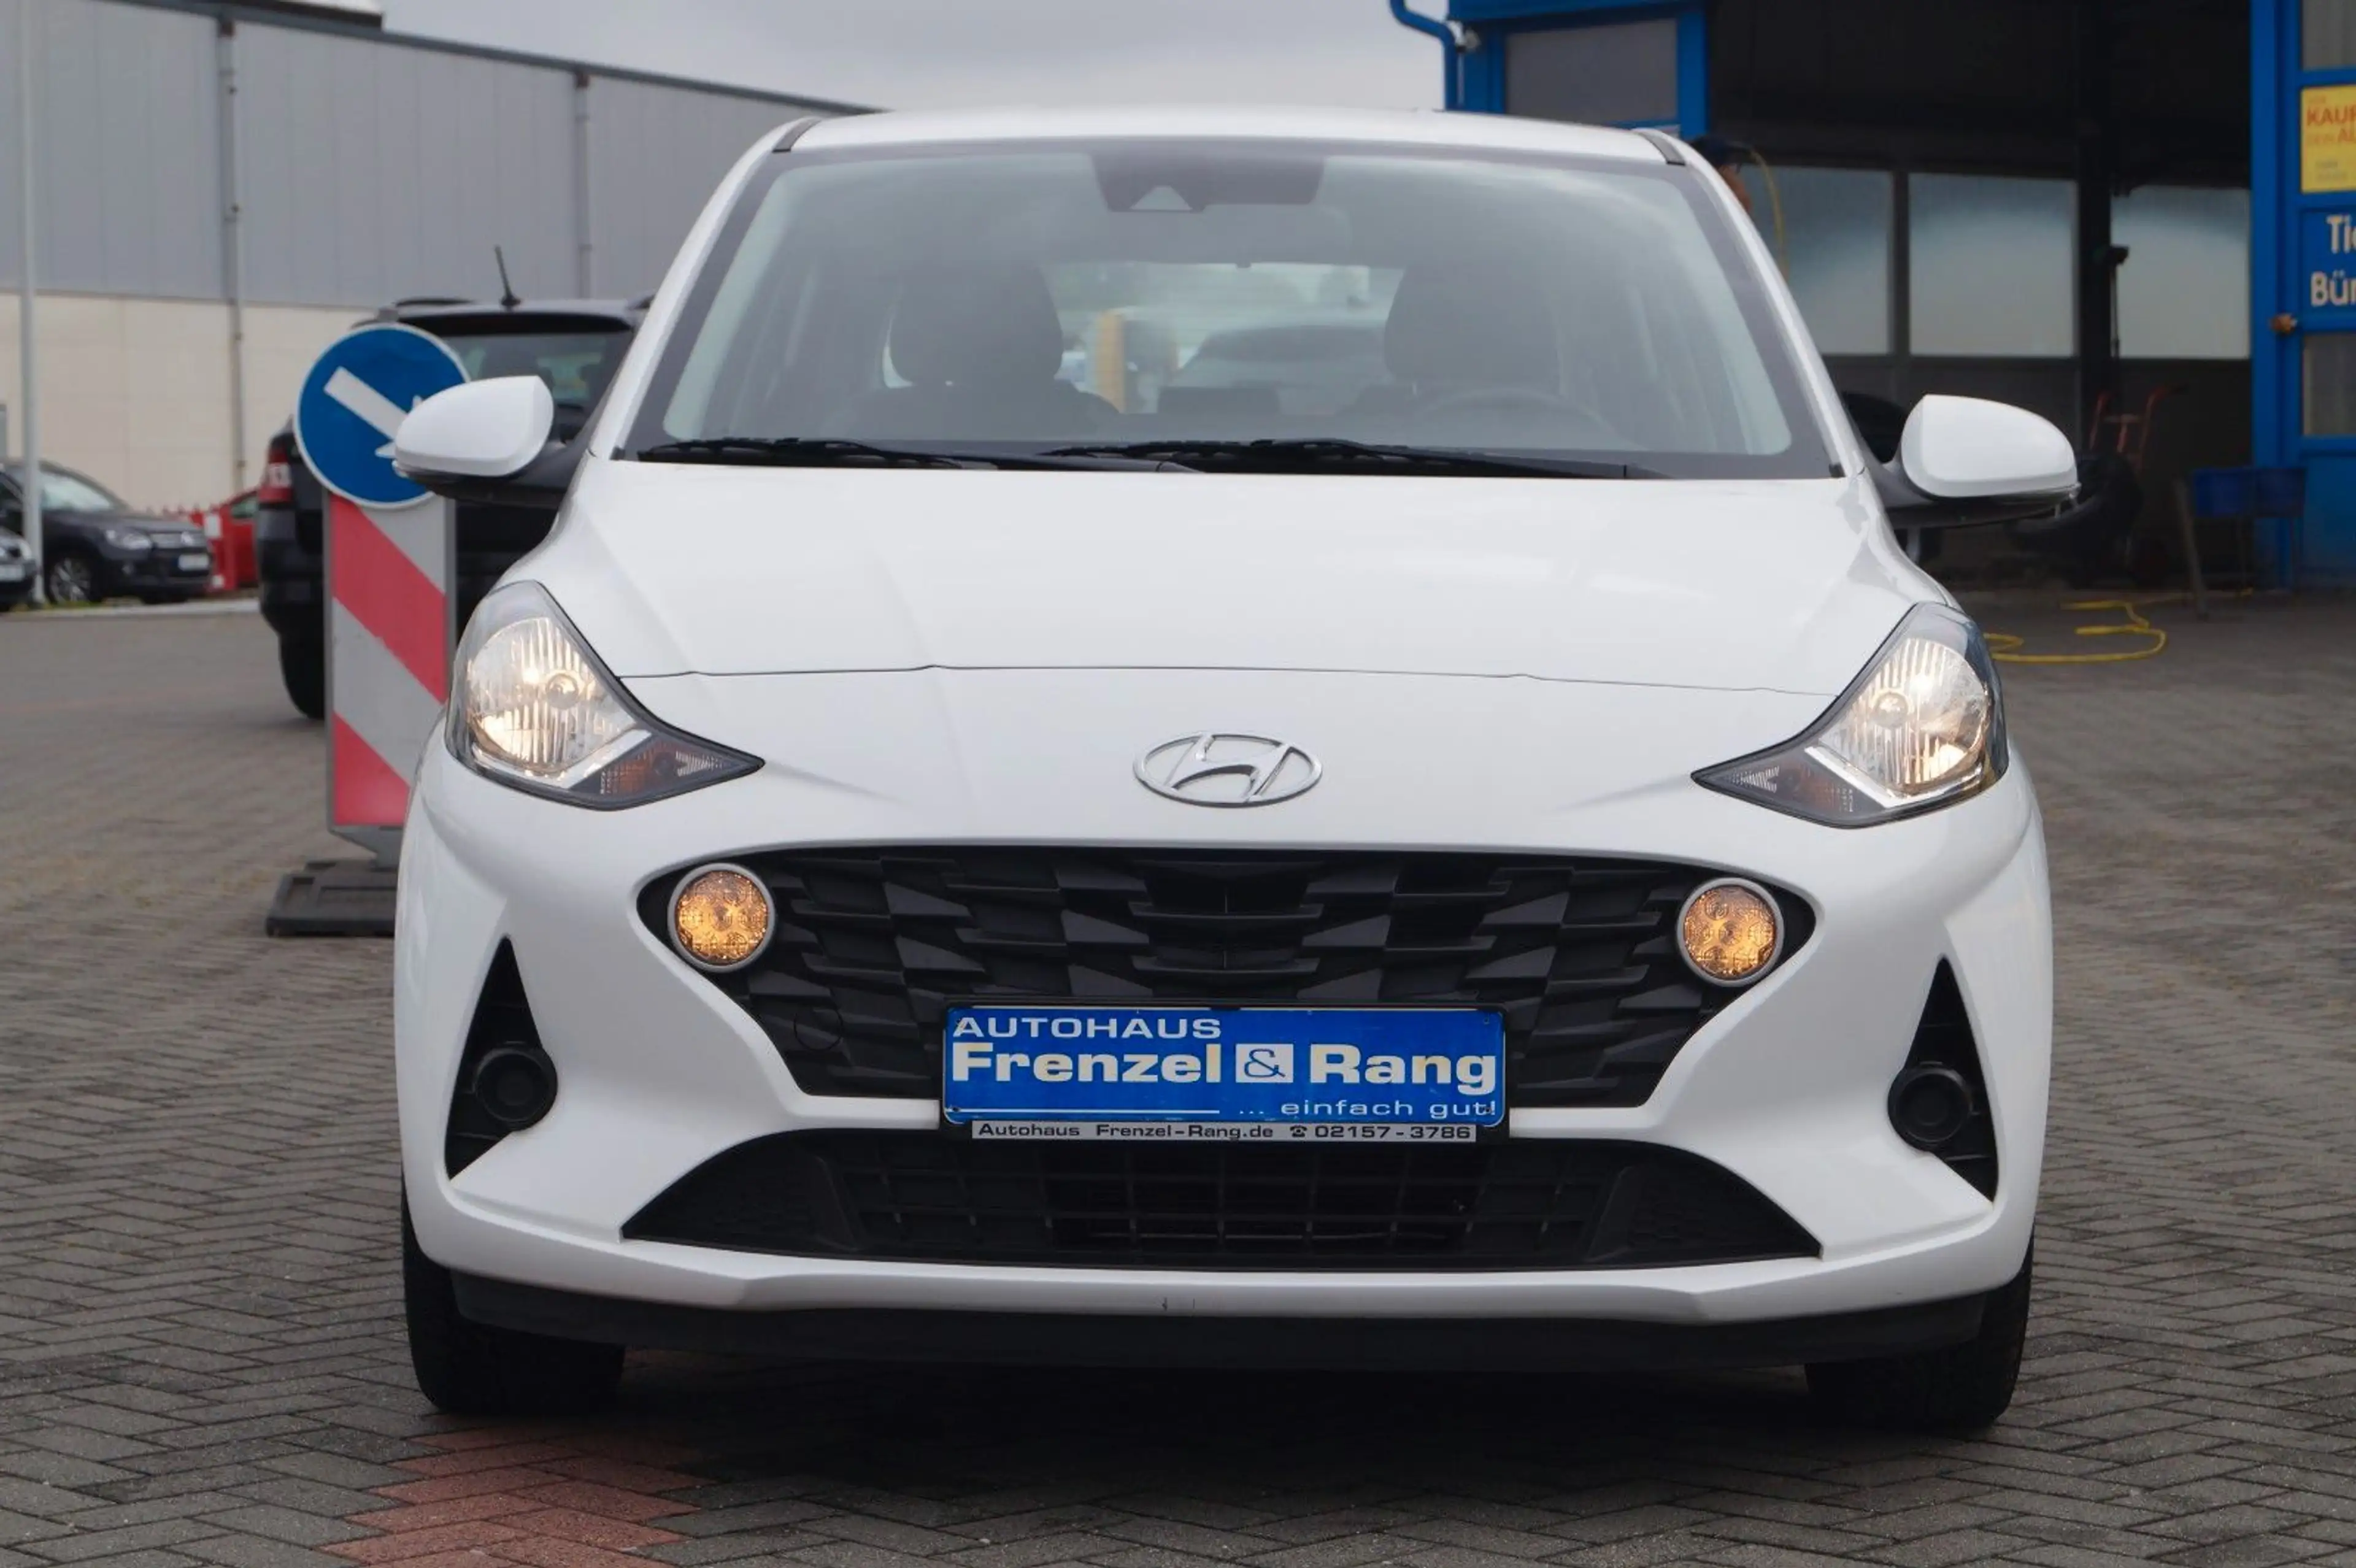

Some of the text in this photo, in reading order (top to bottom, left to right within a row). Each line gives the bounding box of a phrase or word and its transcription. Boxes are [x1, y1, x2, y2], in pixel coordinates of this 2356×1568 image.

[953, 1017, 1222, 1039] AUTOHAUS
[952, 1042, 1496, 1096] Frenzel & Rang
[1280, 1099, 1413, 1116] einfach
[1430, 1100, 1496, 1120] gut!
[978, 1123, 1080, 1136] Autohaus
[1096, 1124, 1274, 1140] Frenzel-Rang.de
